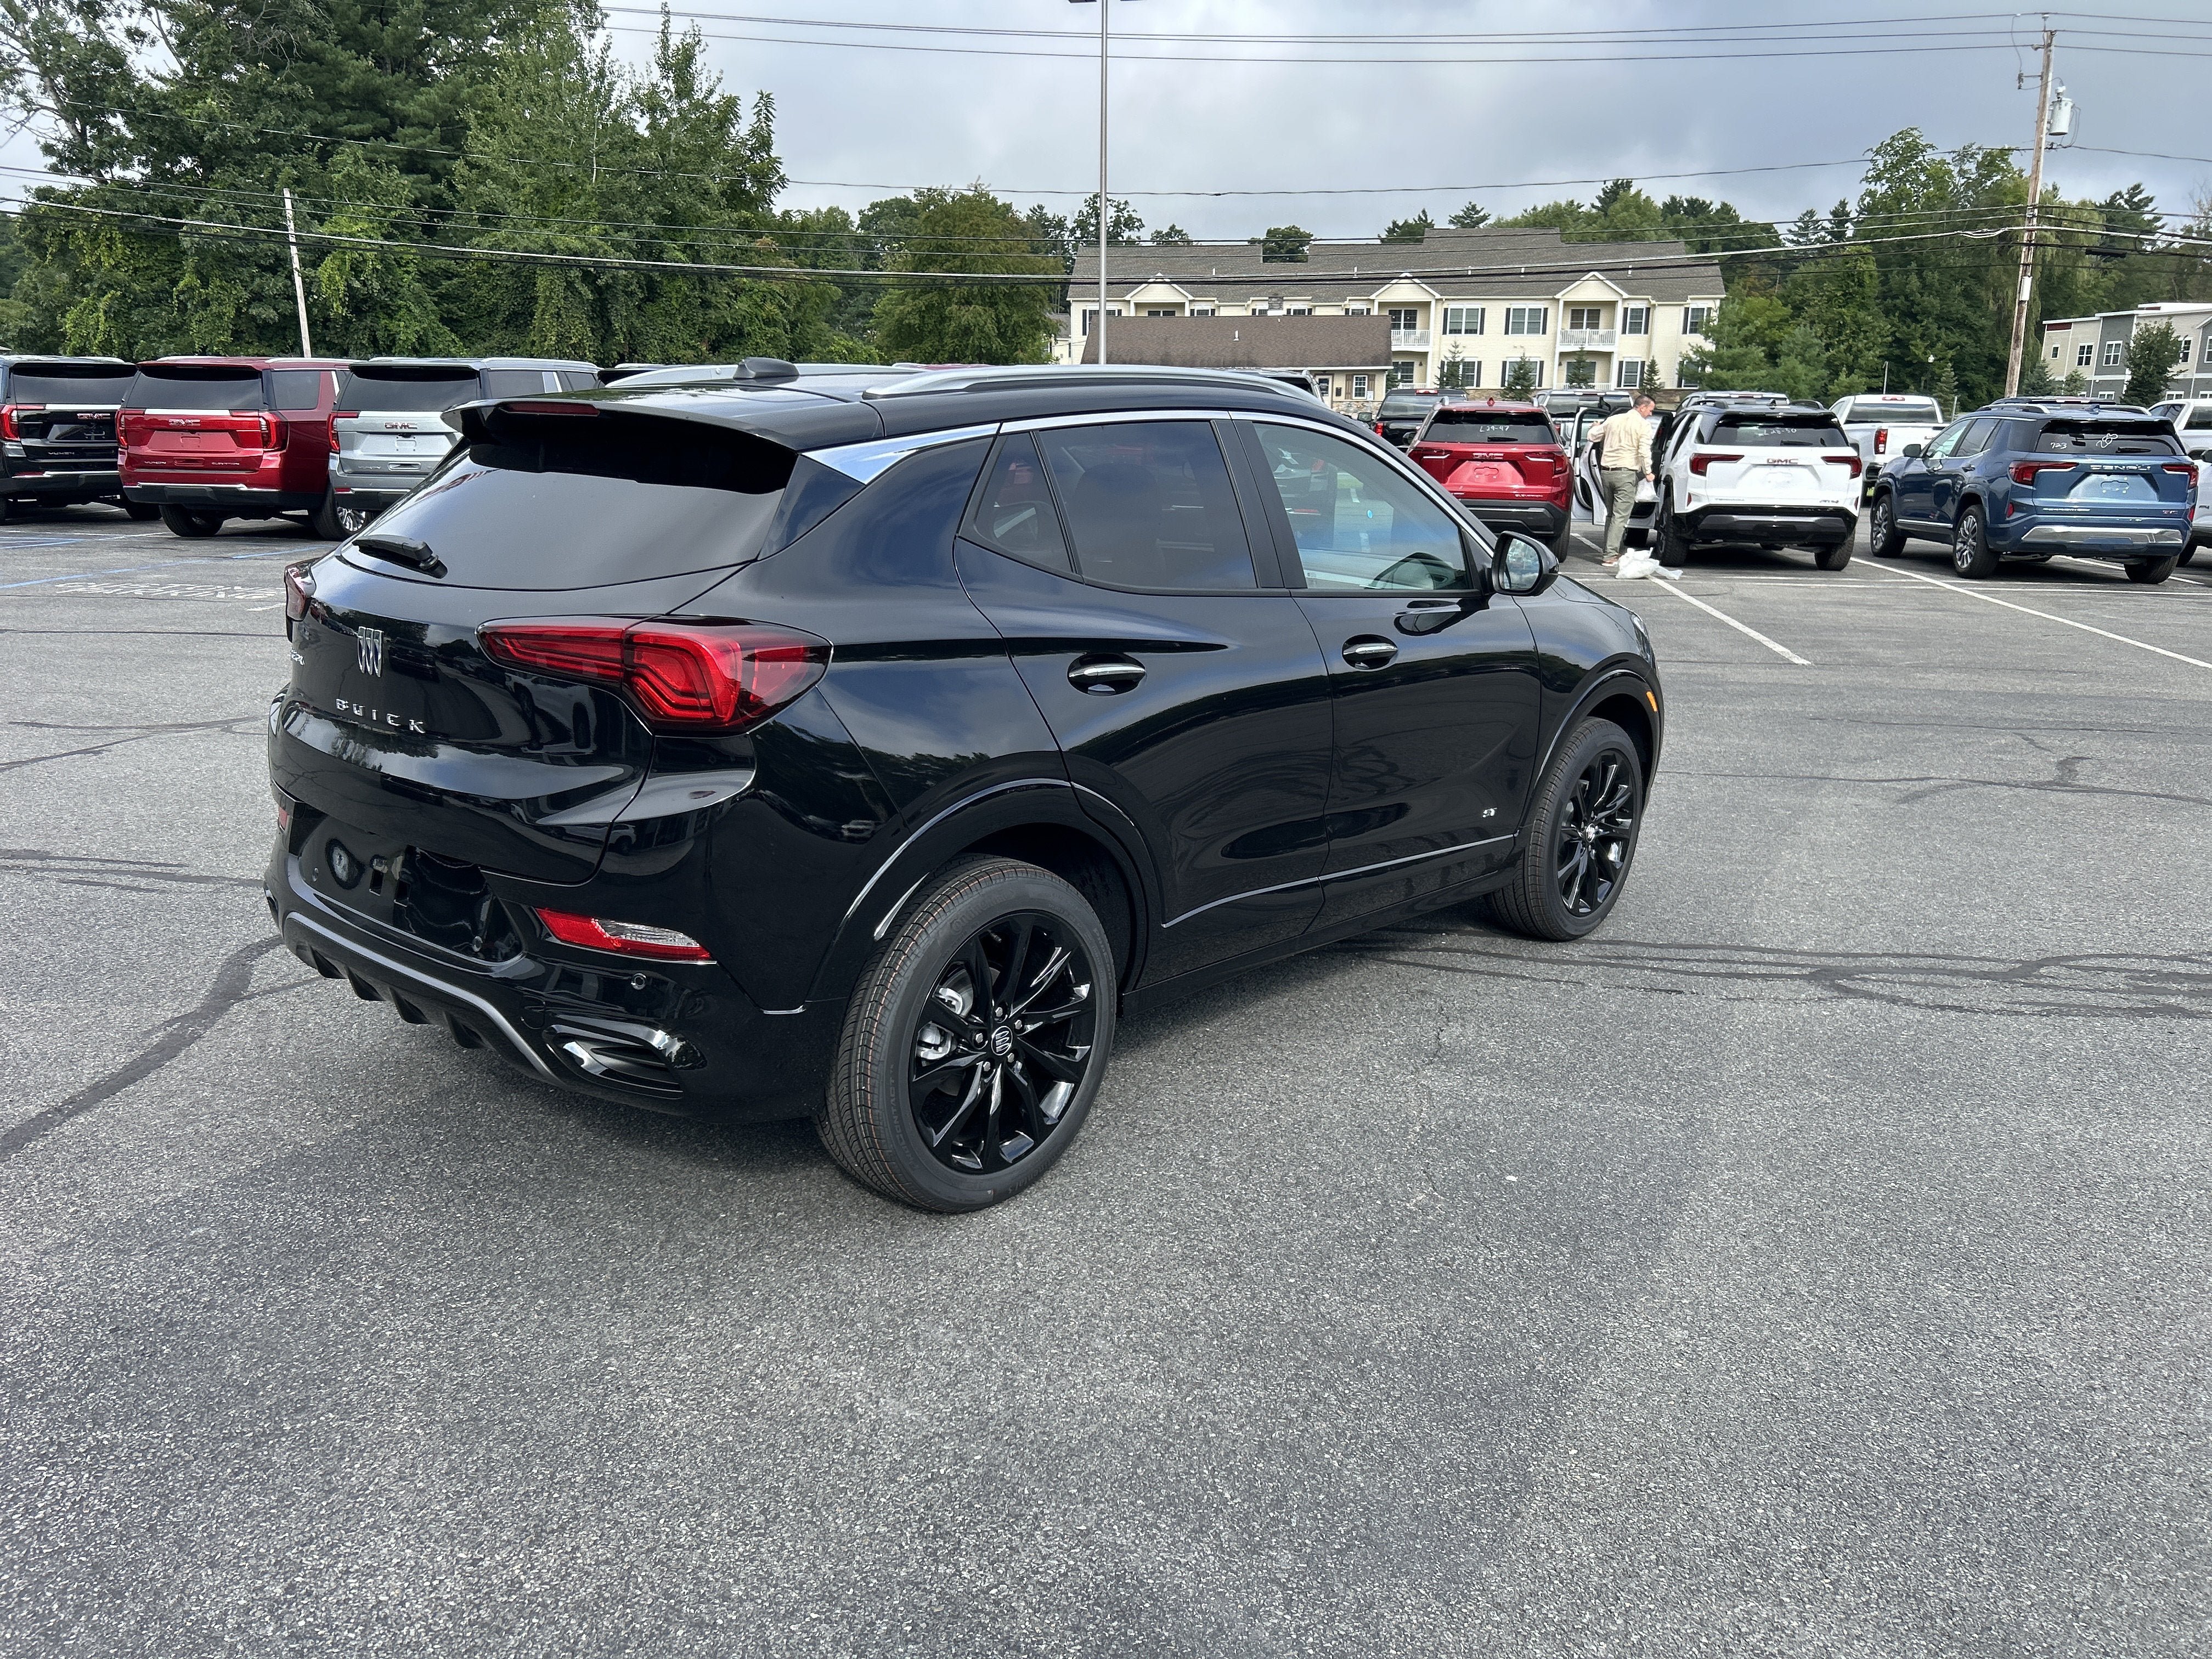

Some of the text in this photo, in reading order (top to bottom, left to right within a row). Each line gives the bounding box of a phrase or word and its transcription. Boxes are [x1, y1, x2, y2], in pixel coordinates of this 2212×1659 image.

[54, 582, 286, 594] CUSTOME
[56, 588, 275, 599] PARKING
[335, 698, 426, 734] BUICK
